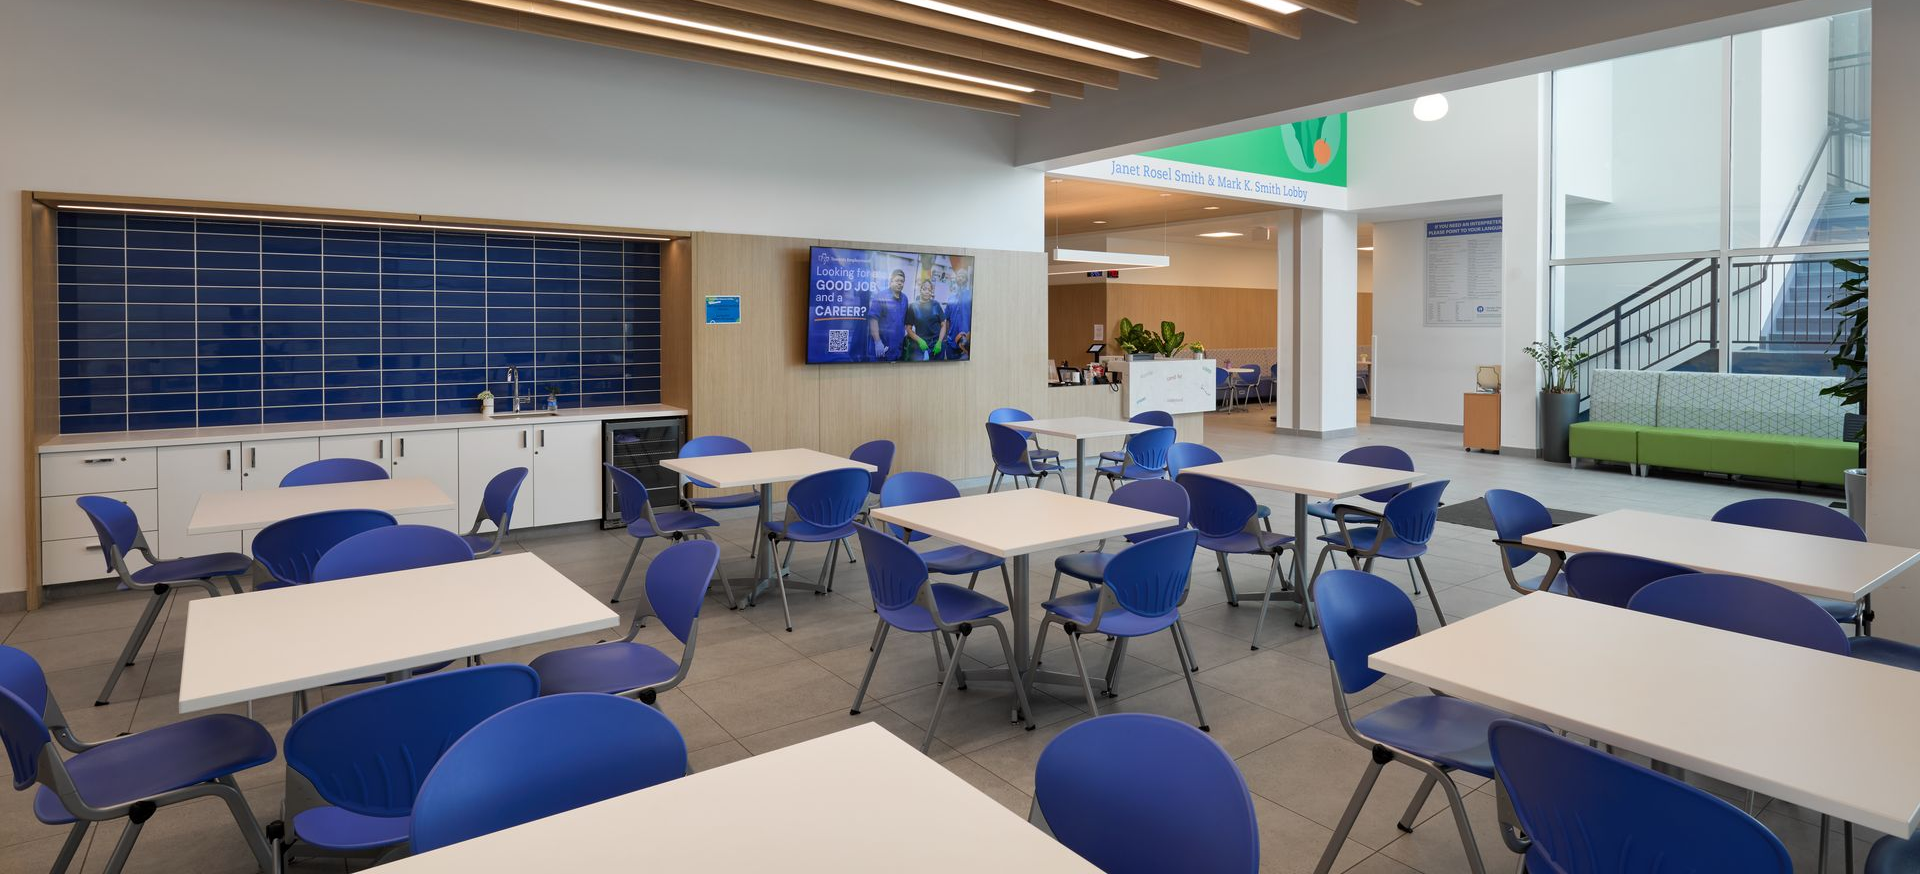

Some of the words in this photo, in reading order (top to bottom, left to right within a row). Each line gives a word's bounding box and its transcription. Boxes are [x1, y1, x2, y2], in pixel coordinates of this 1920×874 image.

[1111, 160, 1140, 176] Janet
[1143, 165, 1172, 180] Rosel
[1175, 169, 1205, 185] Smith
[1208, 174, 1215, 187] &
[1218, 176, 1242, 190] Mark
[1244, 179, 1253, 192] K.
[1255, 181, 1281, 195] Smith
[1283, 185, 1308, 202] Lobby
[816, 266, 855, 280] Looking
[857, 267, 870, 278] for
[816, 279, 852, 291] GOOD
[854, 281, 877, 292] JOB
[815, 292, 835, 302] and
[815, 305, 867, 316] CAREER?
